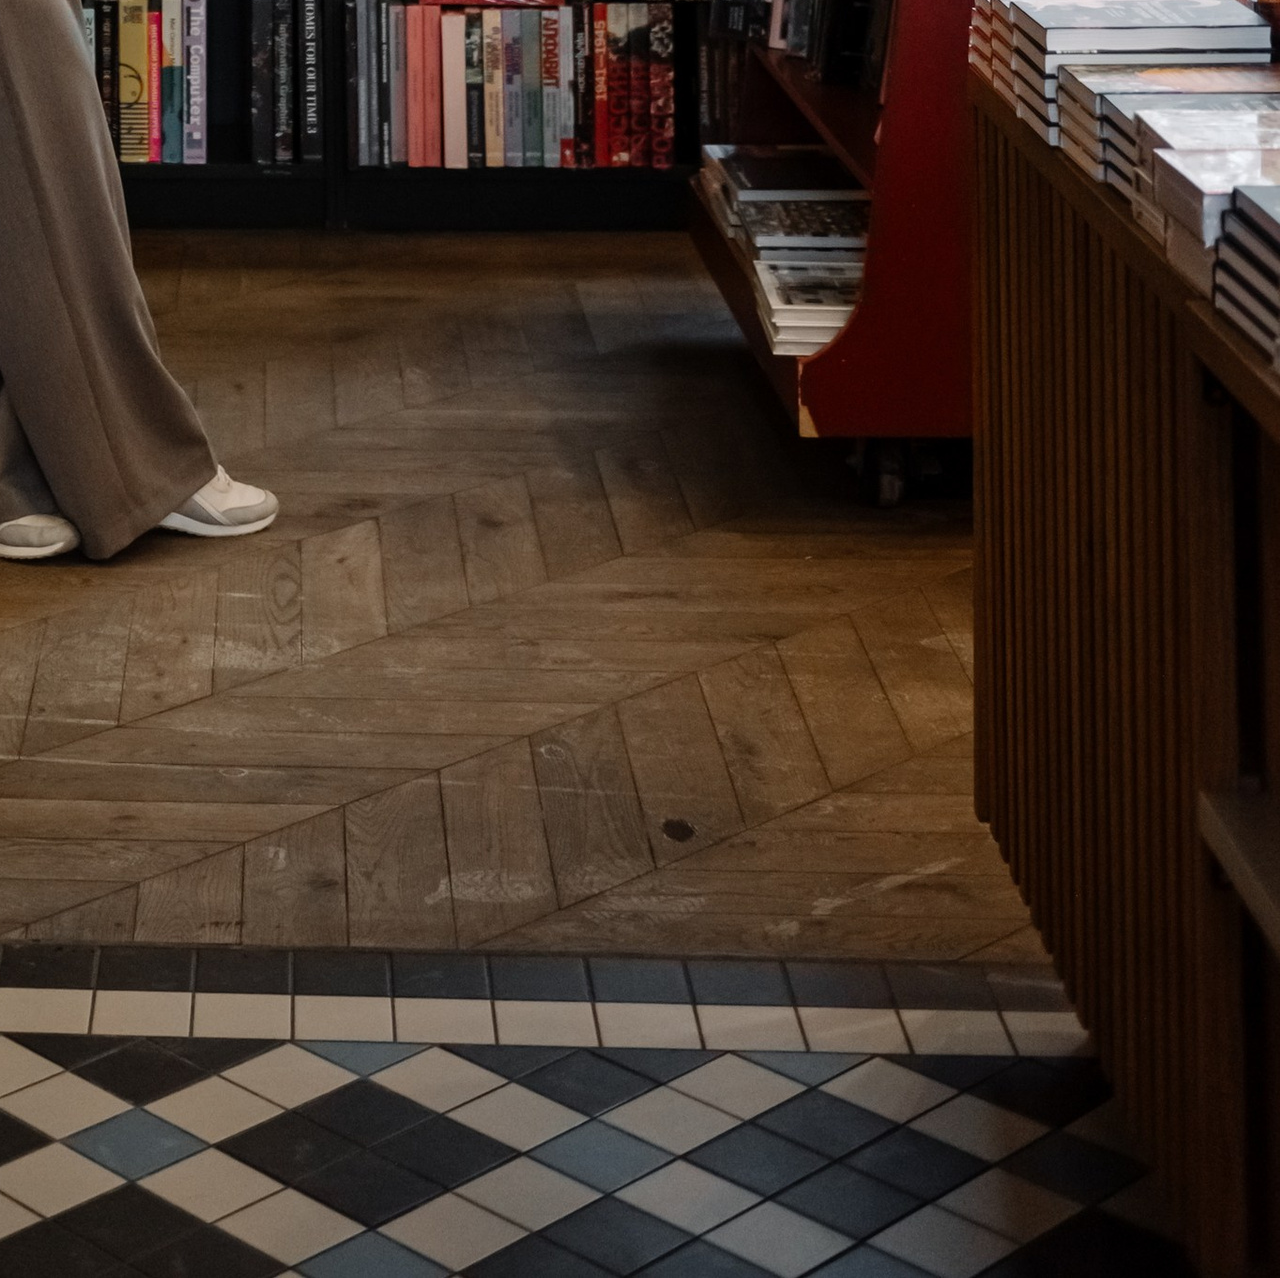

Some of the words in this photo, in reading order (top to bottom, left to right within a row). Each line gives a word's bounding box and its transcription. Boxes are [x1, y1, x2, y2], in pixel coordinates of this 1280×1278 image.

[190, 6, 204, 37] The
[277, 23, 289, 83] Information
[304, 42, 317, 65] FOR
[542, 16, 560, 89] АЛФАВИТ
[187, 45, 204, 125] Computer
[305, 66, 317, 92] OUR
[276, 85, 289, 132] Graphics
[306, 94, 317, 125] TIME
[306, 126, 318, 134] 3
